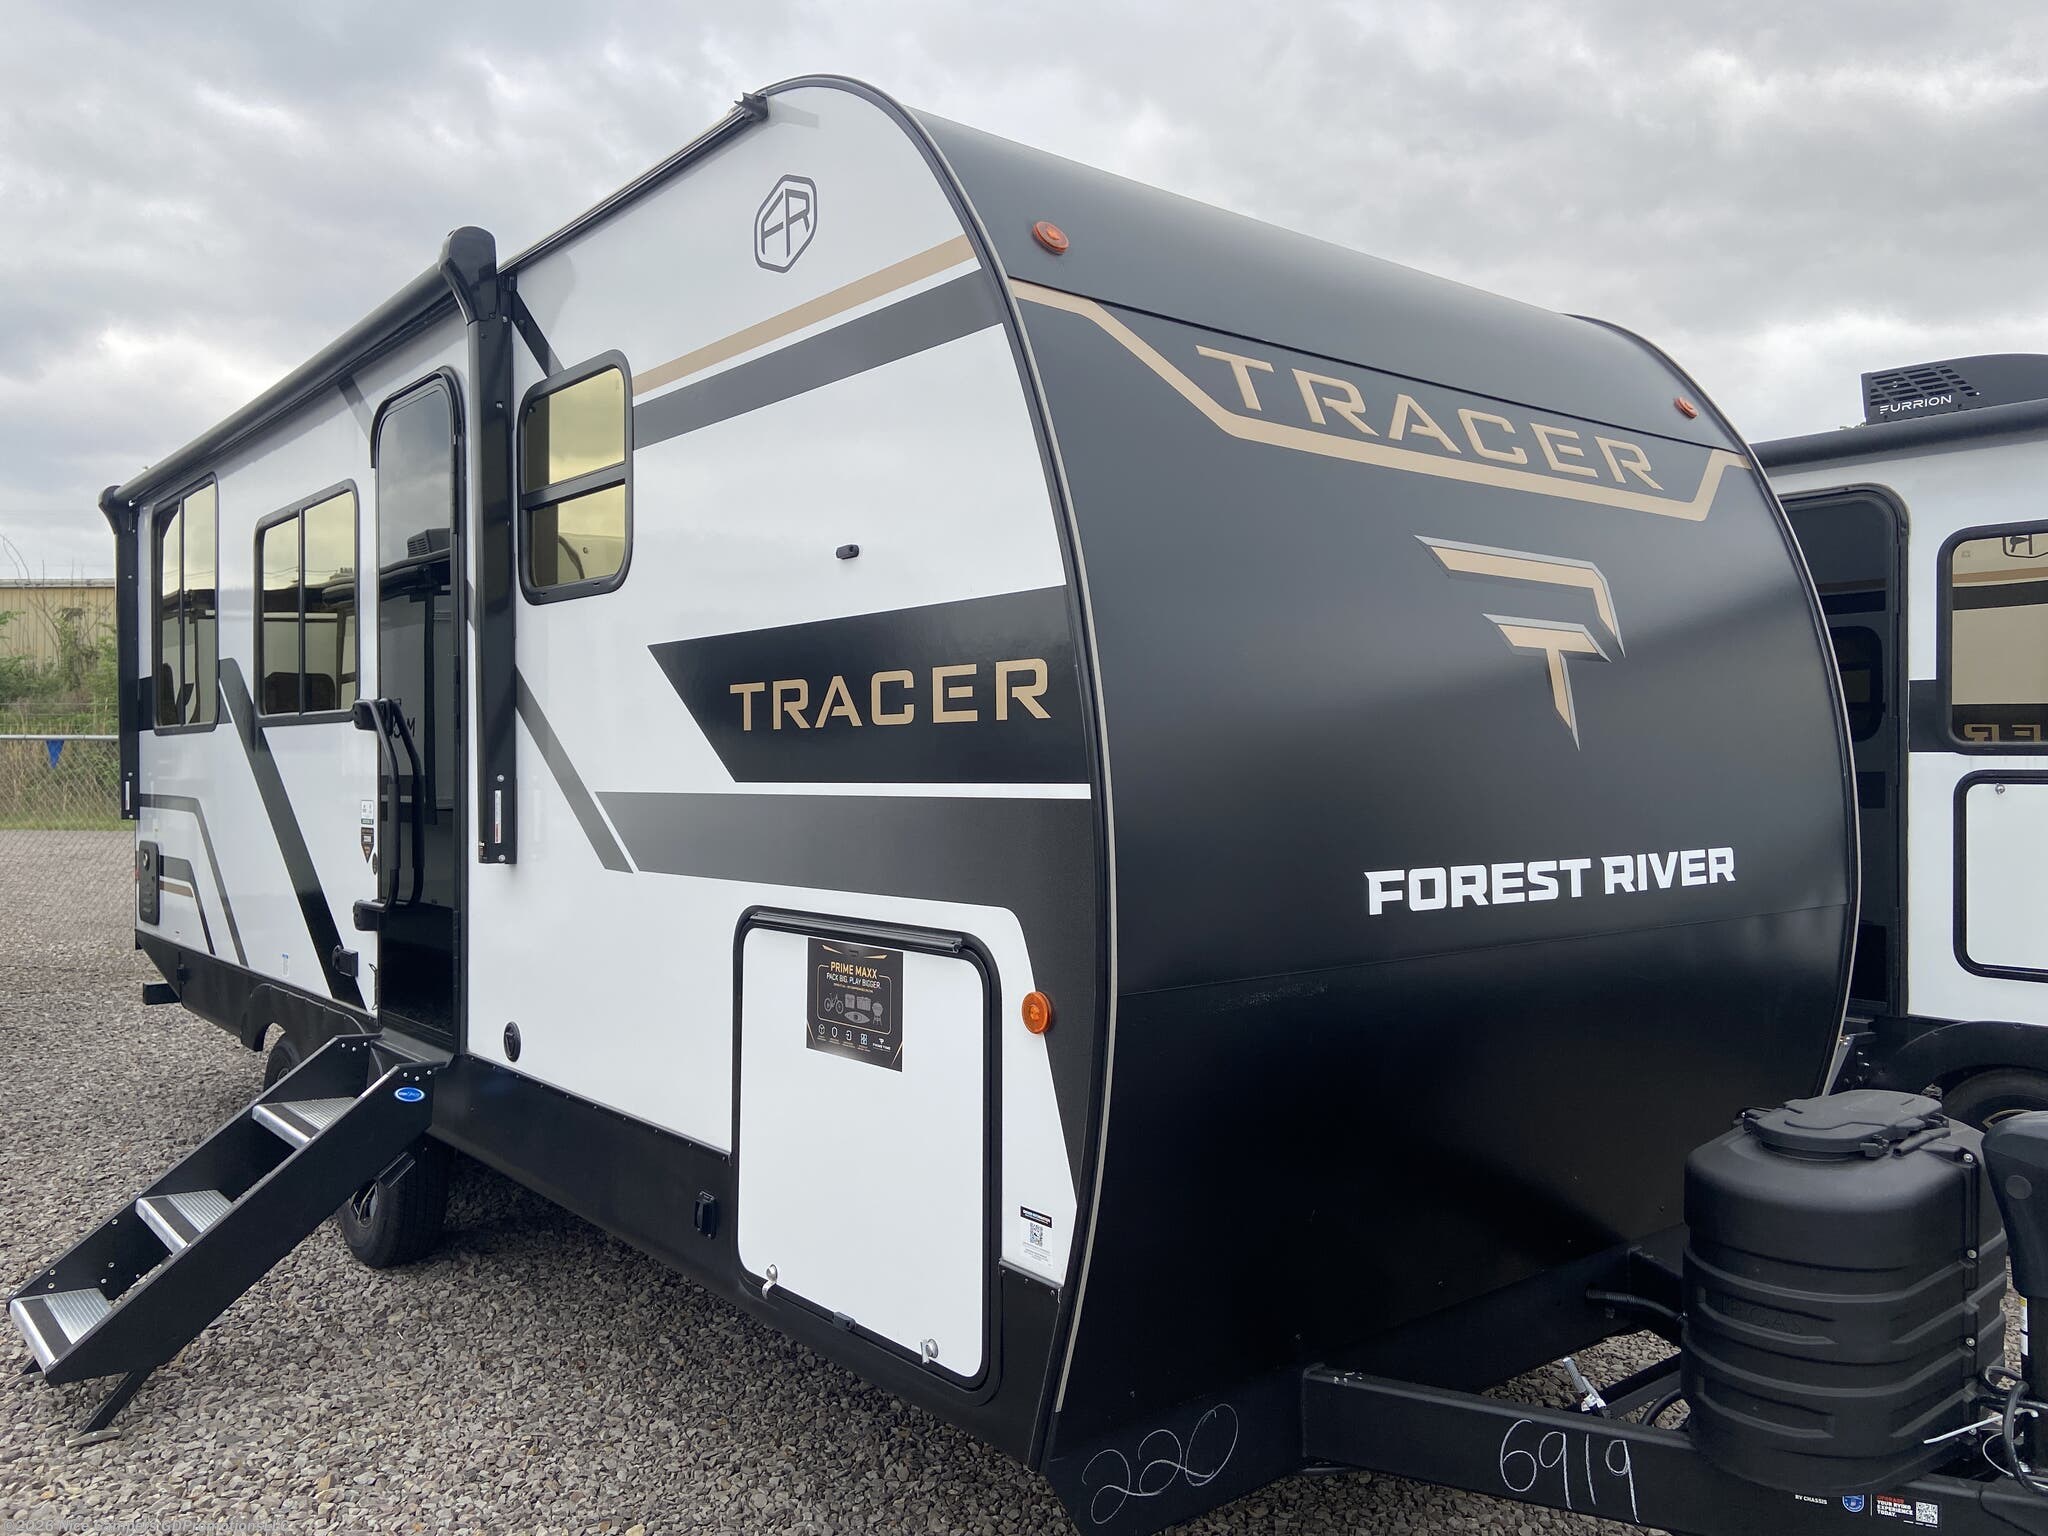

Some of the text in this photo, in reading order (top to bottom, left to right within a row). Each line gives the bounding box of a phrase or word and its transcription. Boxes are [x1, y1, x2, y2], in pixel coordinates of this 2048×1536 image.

[1879, 394, 1953, 415] FURRION
[1195, 344, 1664, 491] TRACER
[729, 657, 1052, 731] TRACER
[1363, 846, 1737, 916] FOREST RIVER
[826, 972, 839, 982] PACK
[849, 976, 861, 985] PLAY
[830, 961, 878, 980] PRIME MAXX
[1081, 1403, 1239, 1525] 220
[1499, 1418, 1640, 1524] 6919
[1803, 1495, 1828, 1505] CHASSIS
[1876, 1499, 1893, 1507] YOUR
[1876, 1504, 1913, 1515] EXPERIENCE
[1876, 1509, 1897, 1518] TODAY.
